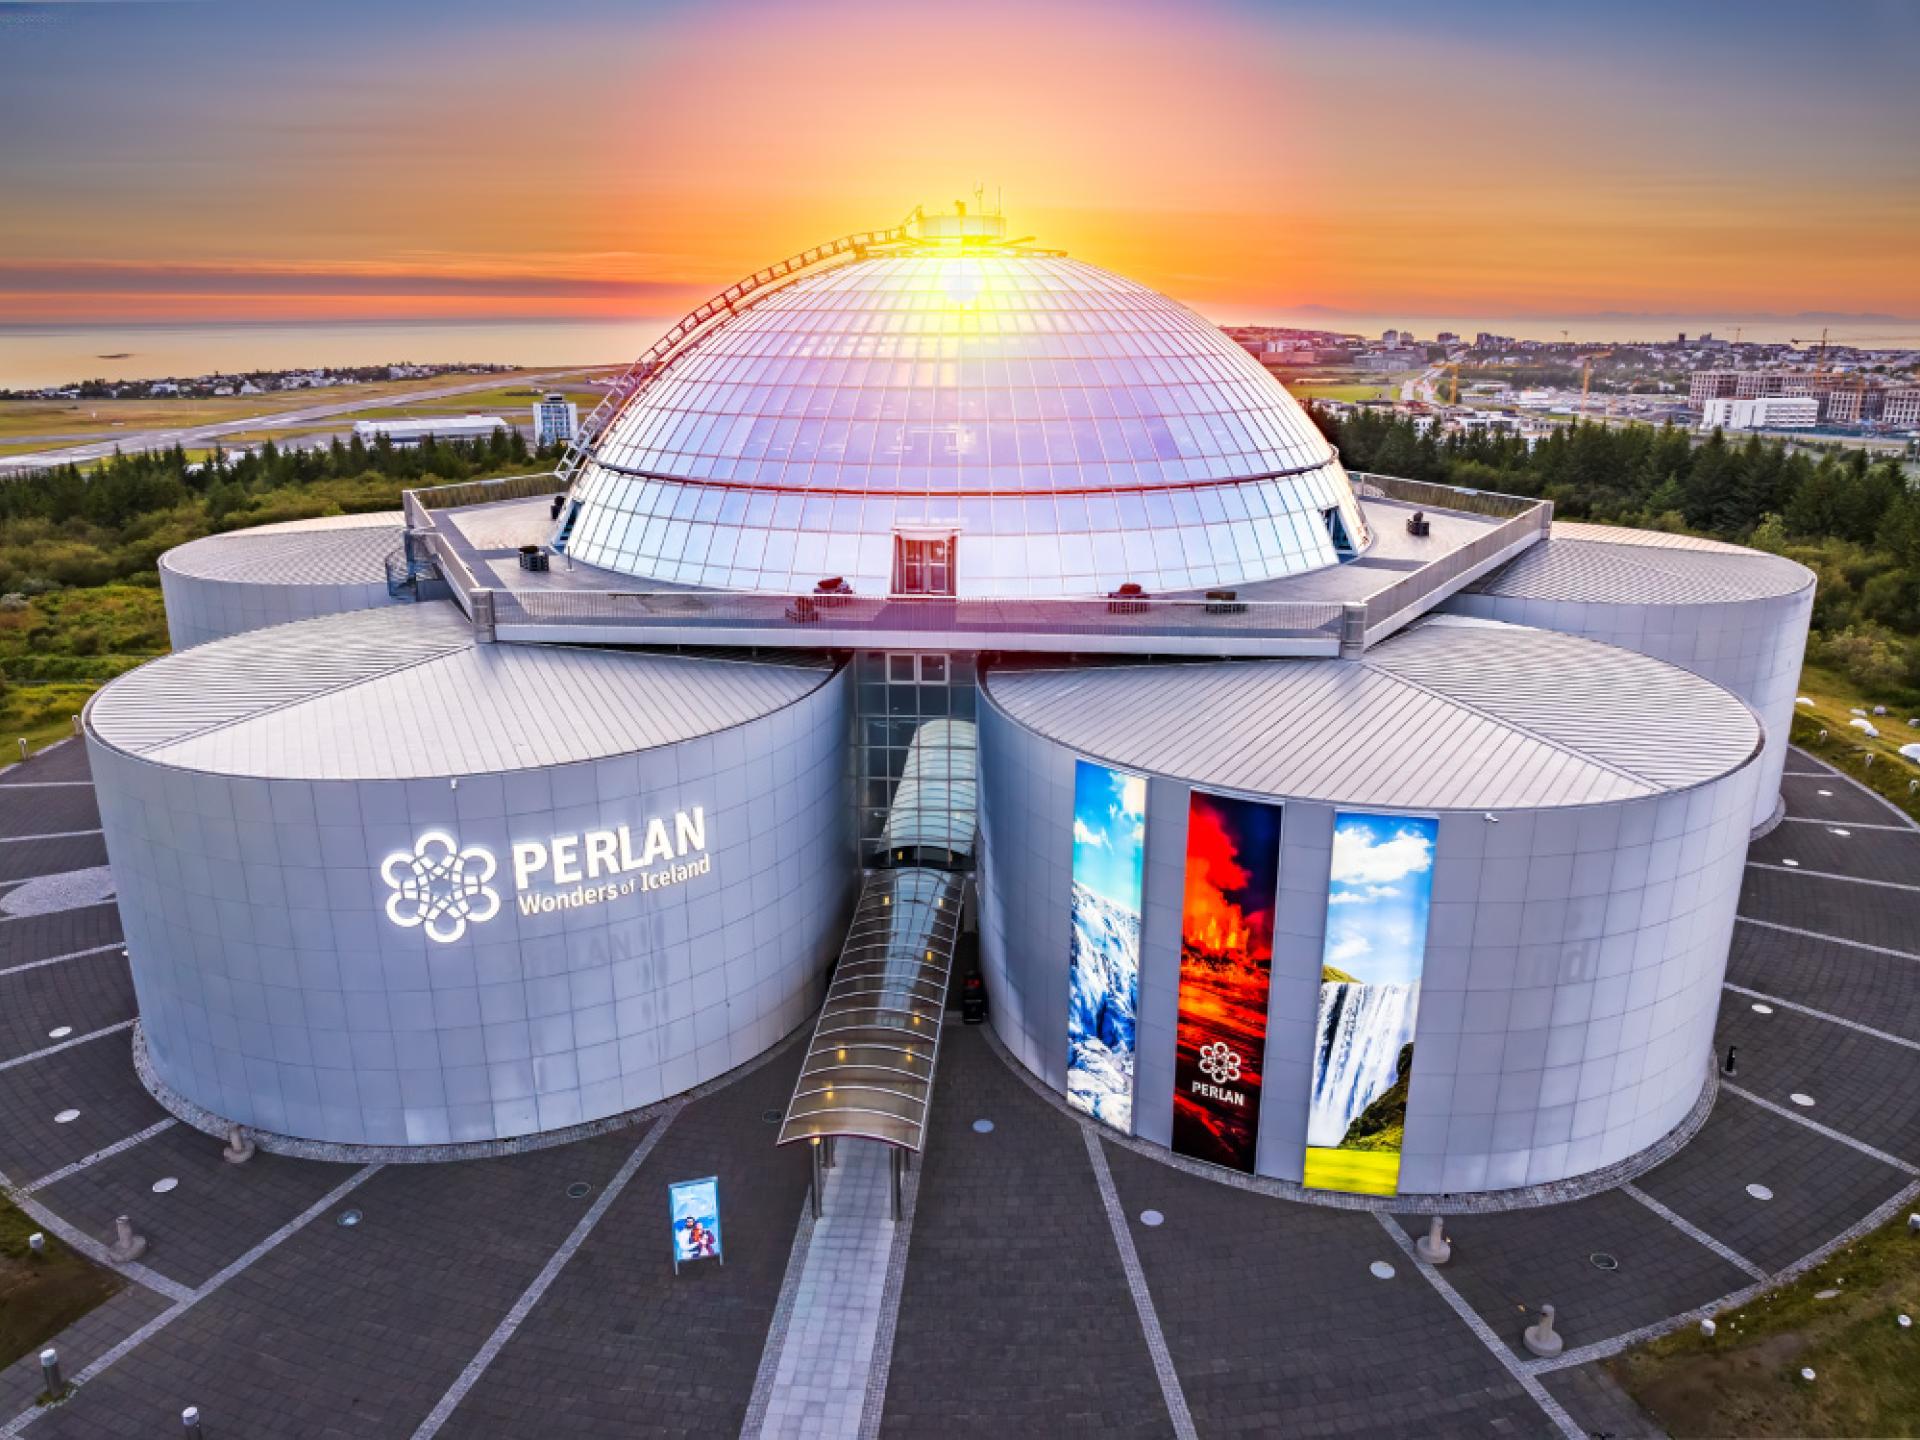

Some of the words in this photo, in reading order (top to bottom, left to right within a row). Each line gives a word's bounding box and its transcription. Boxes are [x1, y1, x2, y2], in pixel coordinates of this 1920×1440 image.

[512, 806, 706, 889] PERLAN
[518, 884, 618, 916] Wonders
[621, 878, 636, 896] of
[640, 853, 711, 893] Iceland
[1191, 1080, 1245, 1106] PERLAN
